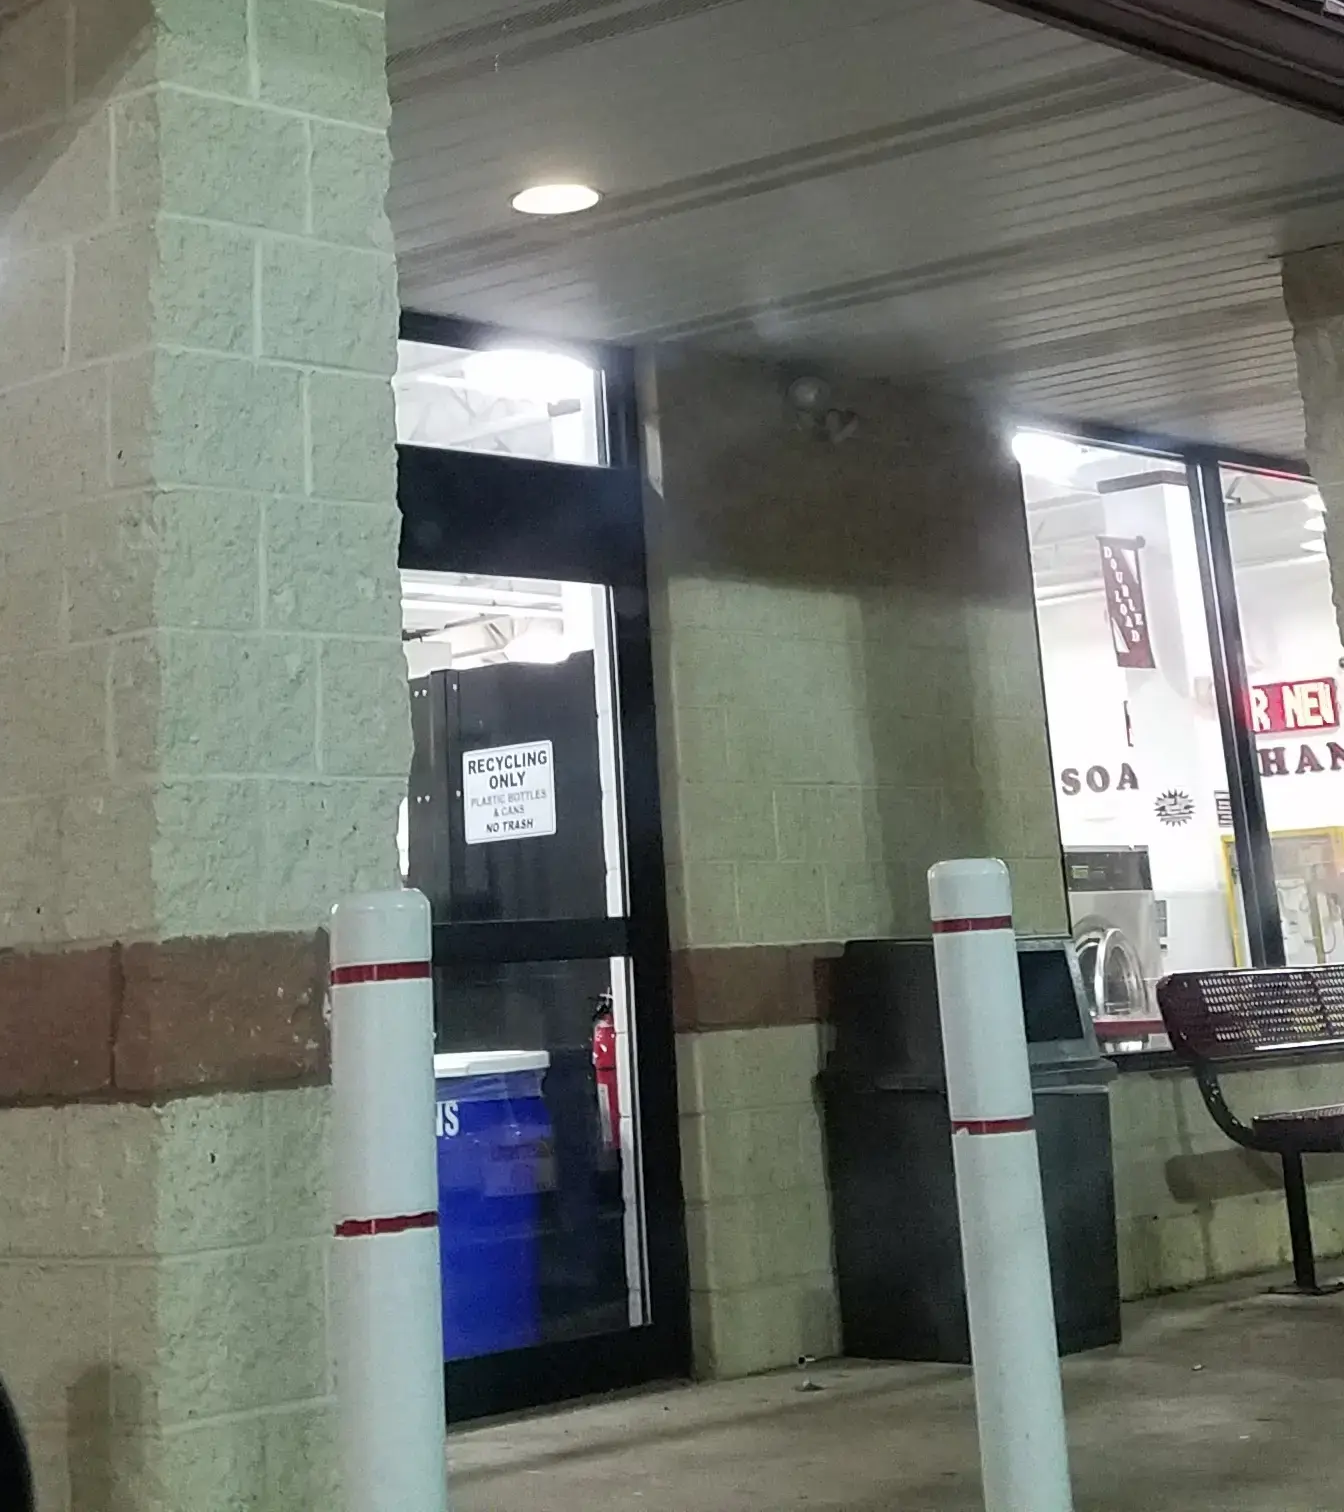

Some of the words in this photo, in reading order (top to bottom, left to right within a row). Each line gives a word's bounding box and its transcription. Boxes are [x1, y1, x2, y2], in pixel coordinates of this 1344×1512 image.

[468, 750, 548, 775] RECYCLING
[489, 771, 526, 789] ONLY
[471, 794, 505, 808] PLASTIC
[507, 789, 546, 803] BOTTLES
[486, 822, 499, 833] NO
[503, 818, 534, 832] TRASH
